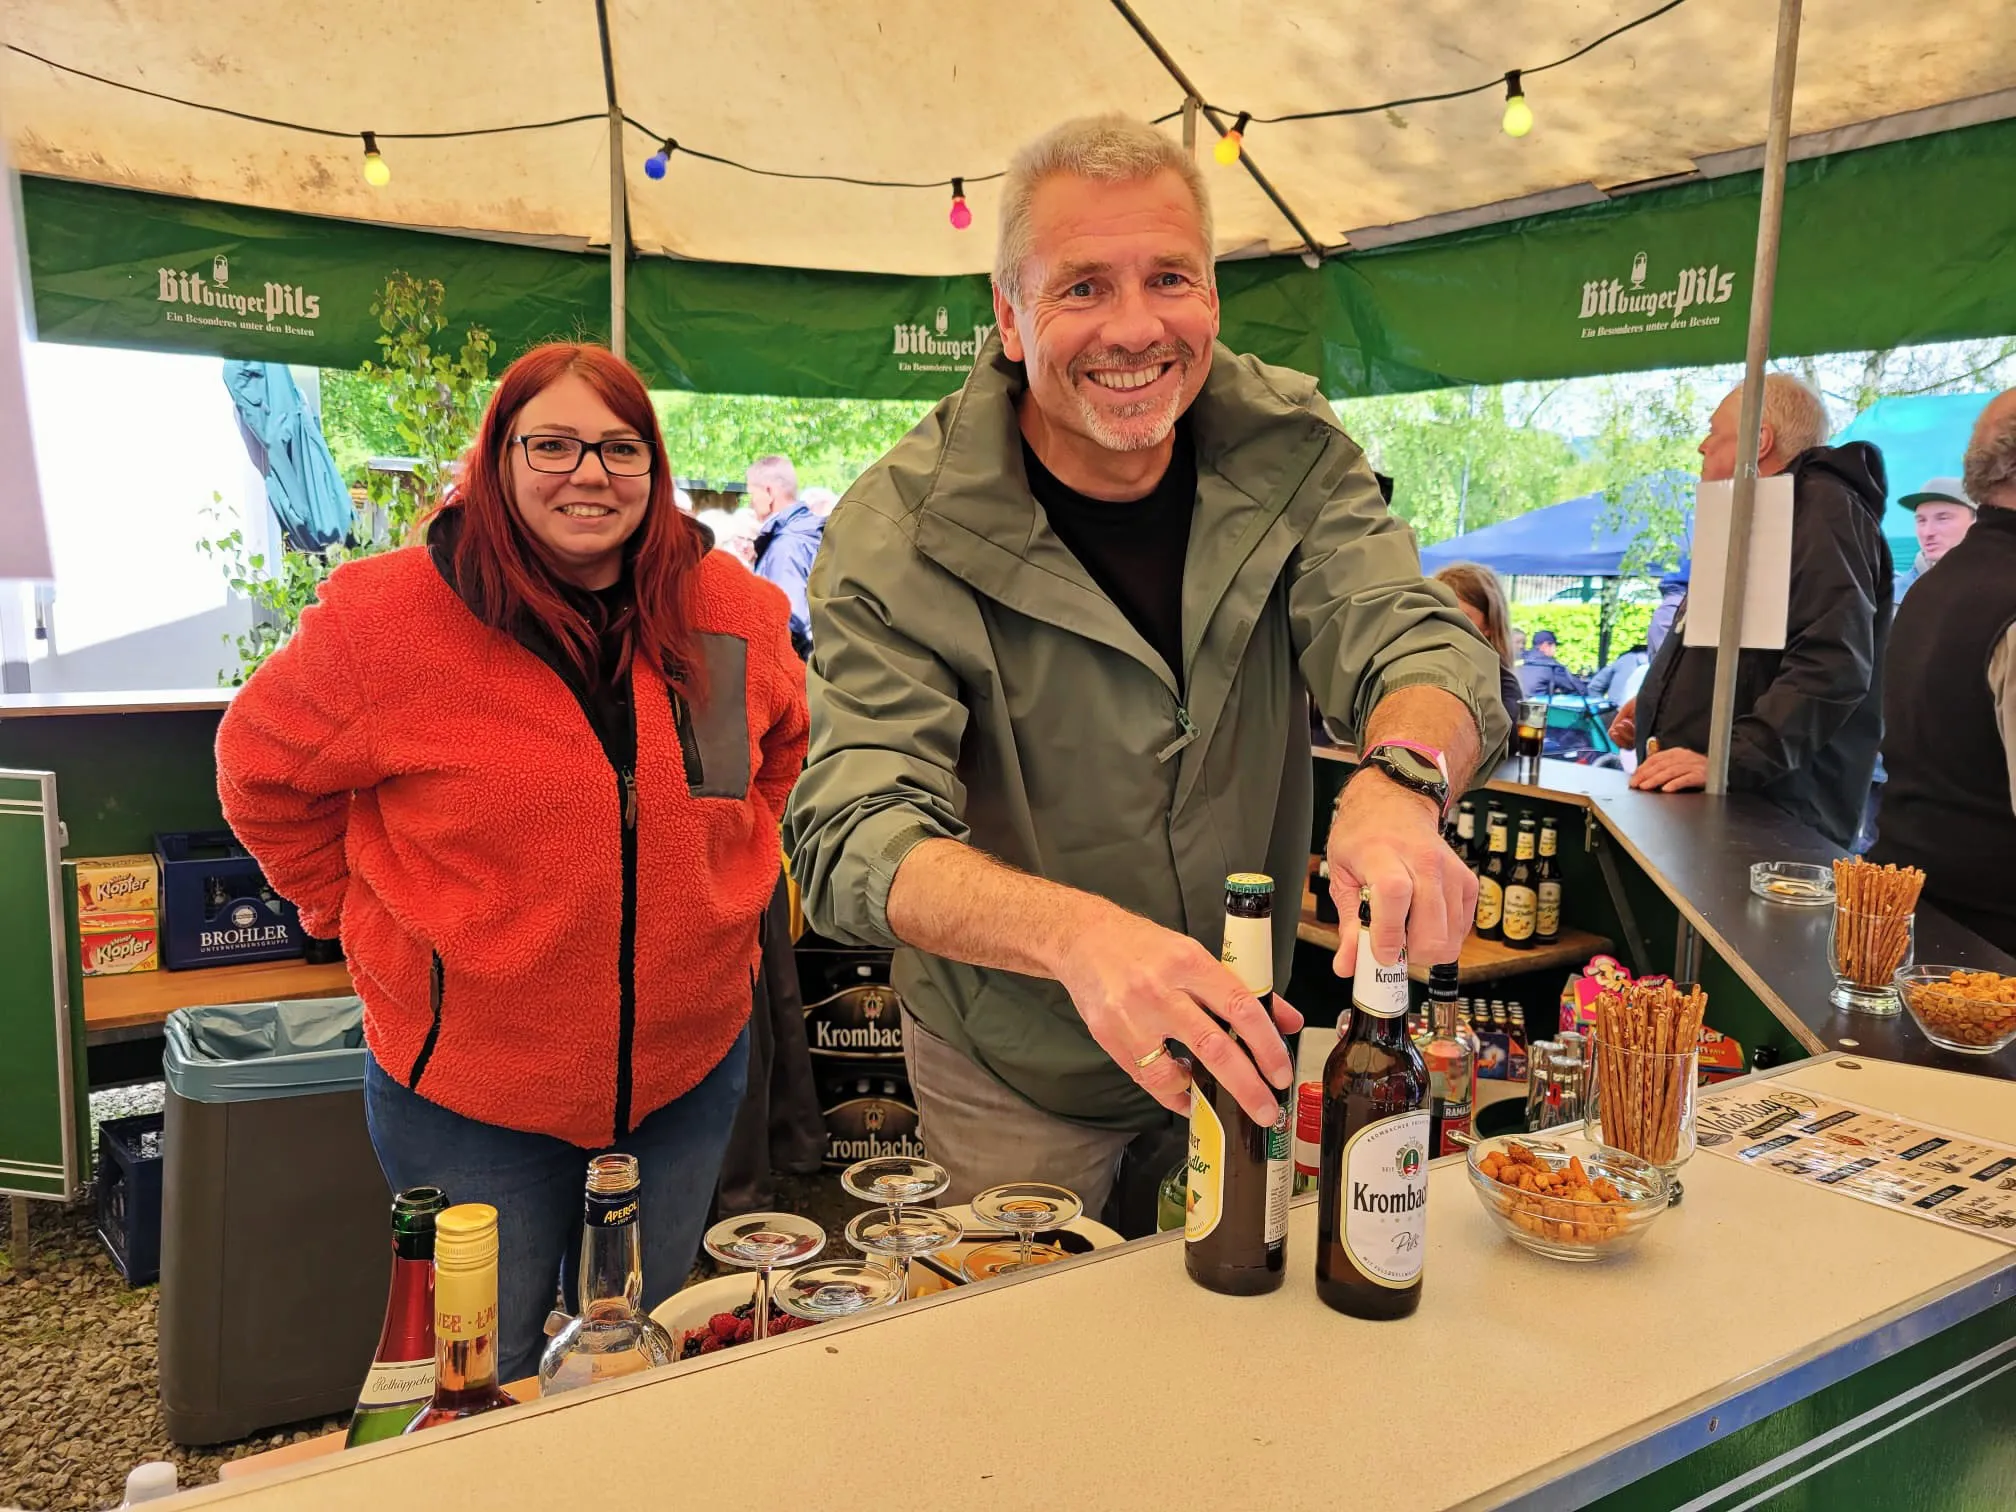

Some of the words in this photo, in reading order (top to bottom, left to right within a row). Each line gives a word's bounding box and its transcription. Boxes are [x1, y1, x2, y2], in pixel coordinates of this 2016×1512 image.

[166, 311, 183, 322] Ein
[185, 314, 237, 328] Besonderes
[239, 320, 263, 332] unter
[265, 323, 282, 333] den
[284, 324, 315, 337] Besten
[1581, 327, 1596, 338] Ein
[1597, 323, 1644, 337] Besonderes
[1645, 320, 1669, 332] unter
[1670, 318, 1687, 329] den
[1689, 315, 1721, 328] Besten
[96, 875, 150, 901] Klopfer
[200, 924, 289, 947] BROHLER
[200, 938, 289, 953] UNTERNEHMENSGRUPPE
[96, 937, 152, 965] Klopfer
[603, 1200, 638, 1224] APEROL
